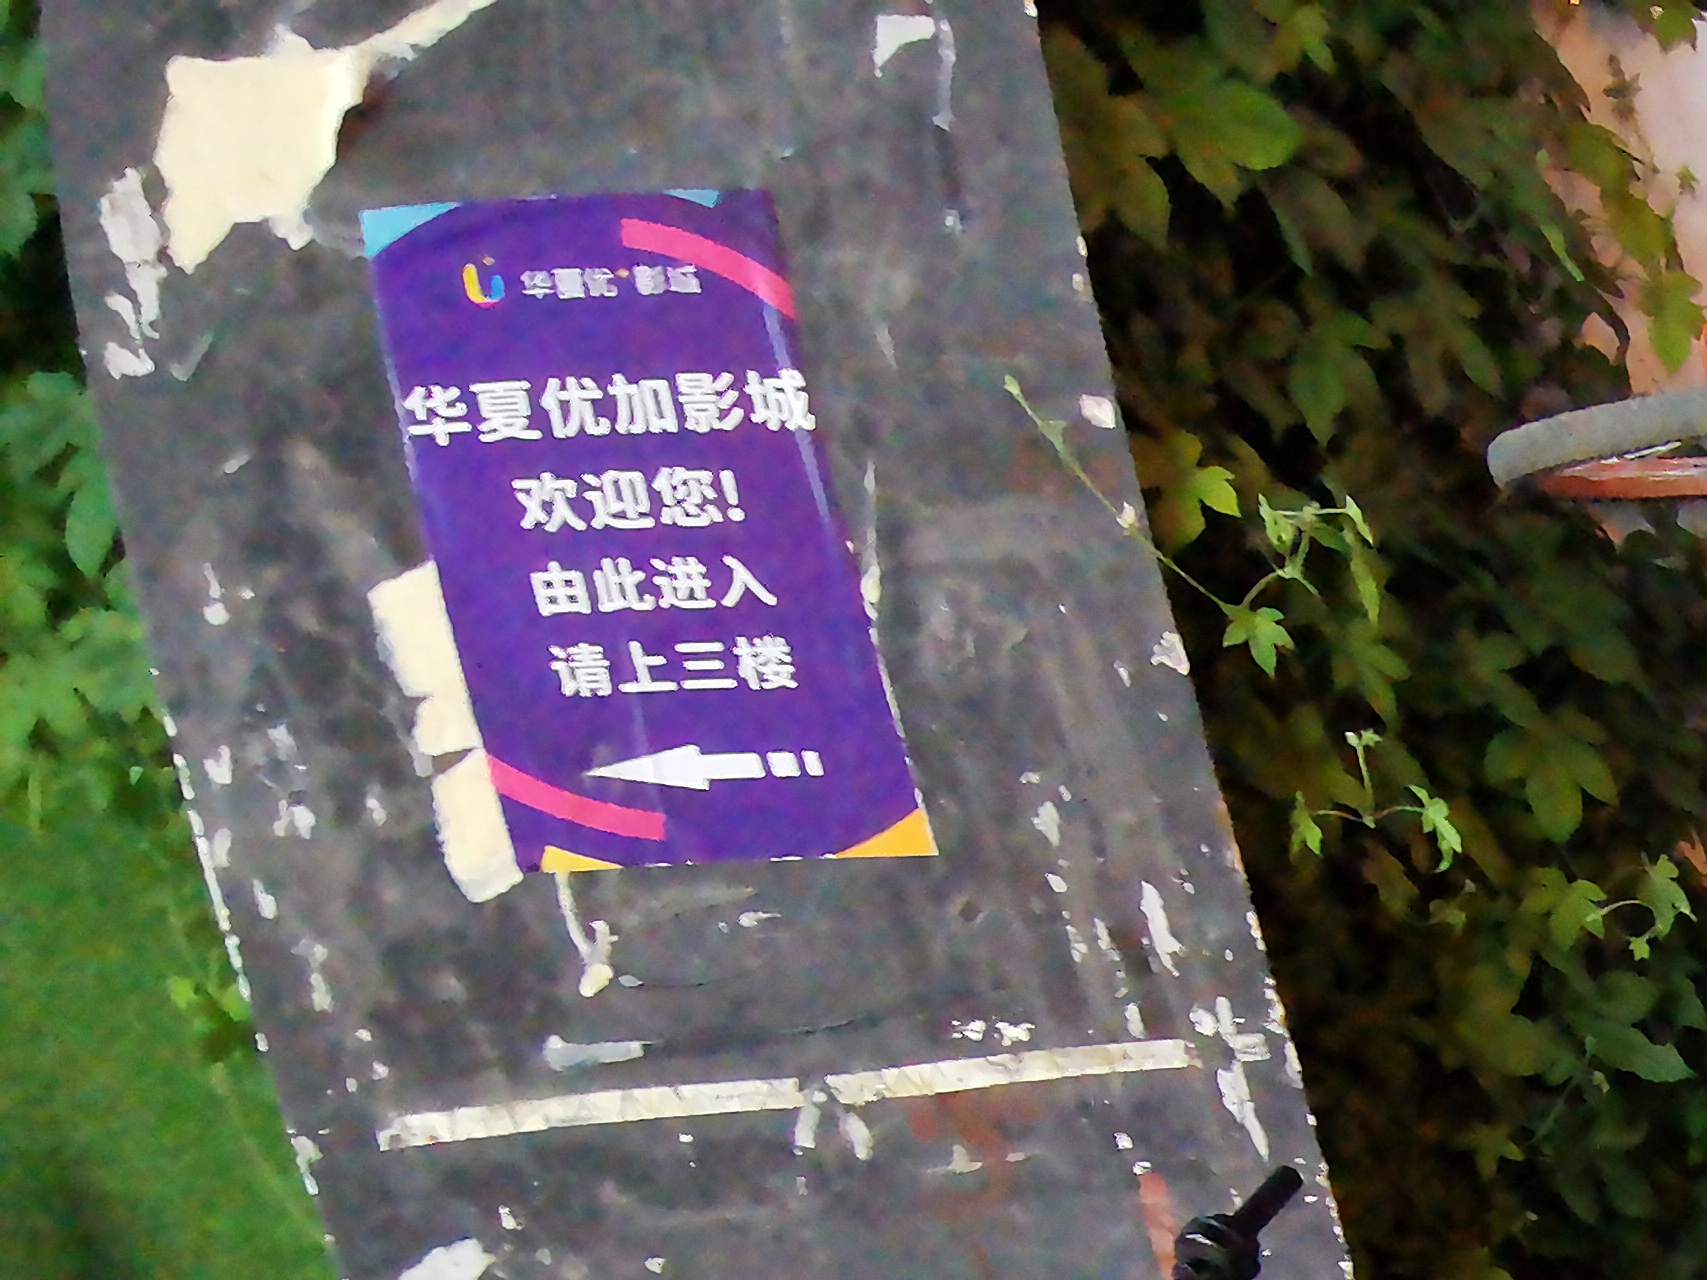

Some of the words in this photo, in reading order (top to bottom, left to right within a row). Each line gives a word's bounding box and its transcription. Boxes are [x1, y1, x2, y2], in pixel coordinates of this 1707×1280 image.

[404, 367, 815, 446] 华夏优加影城
[511, 466, 746, 532] 欢迎您!
[529, 555, 778, 617] 由此进入
[547, 634, 799, 699] 请上三楼
